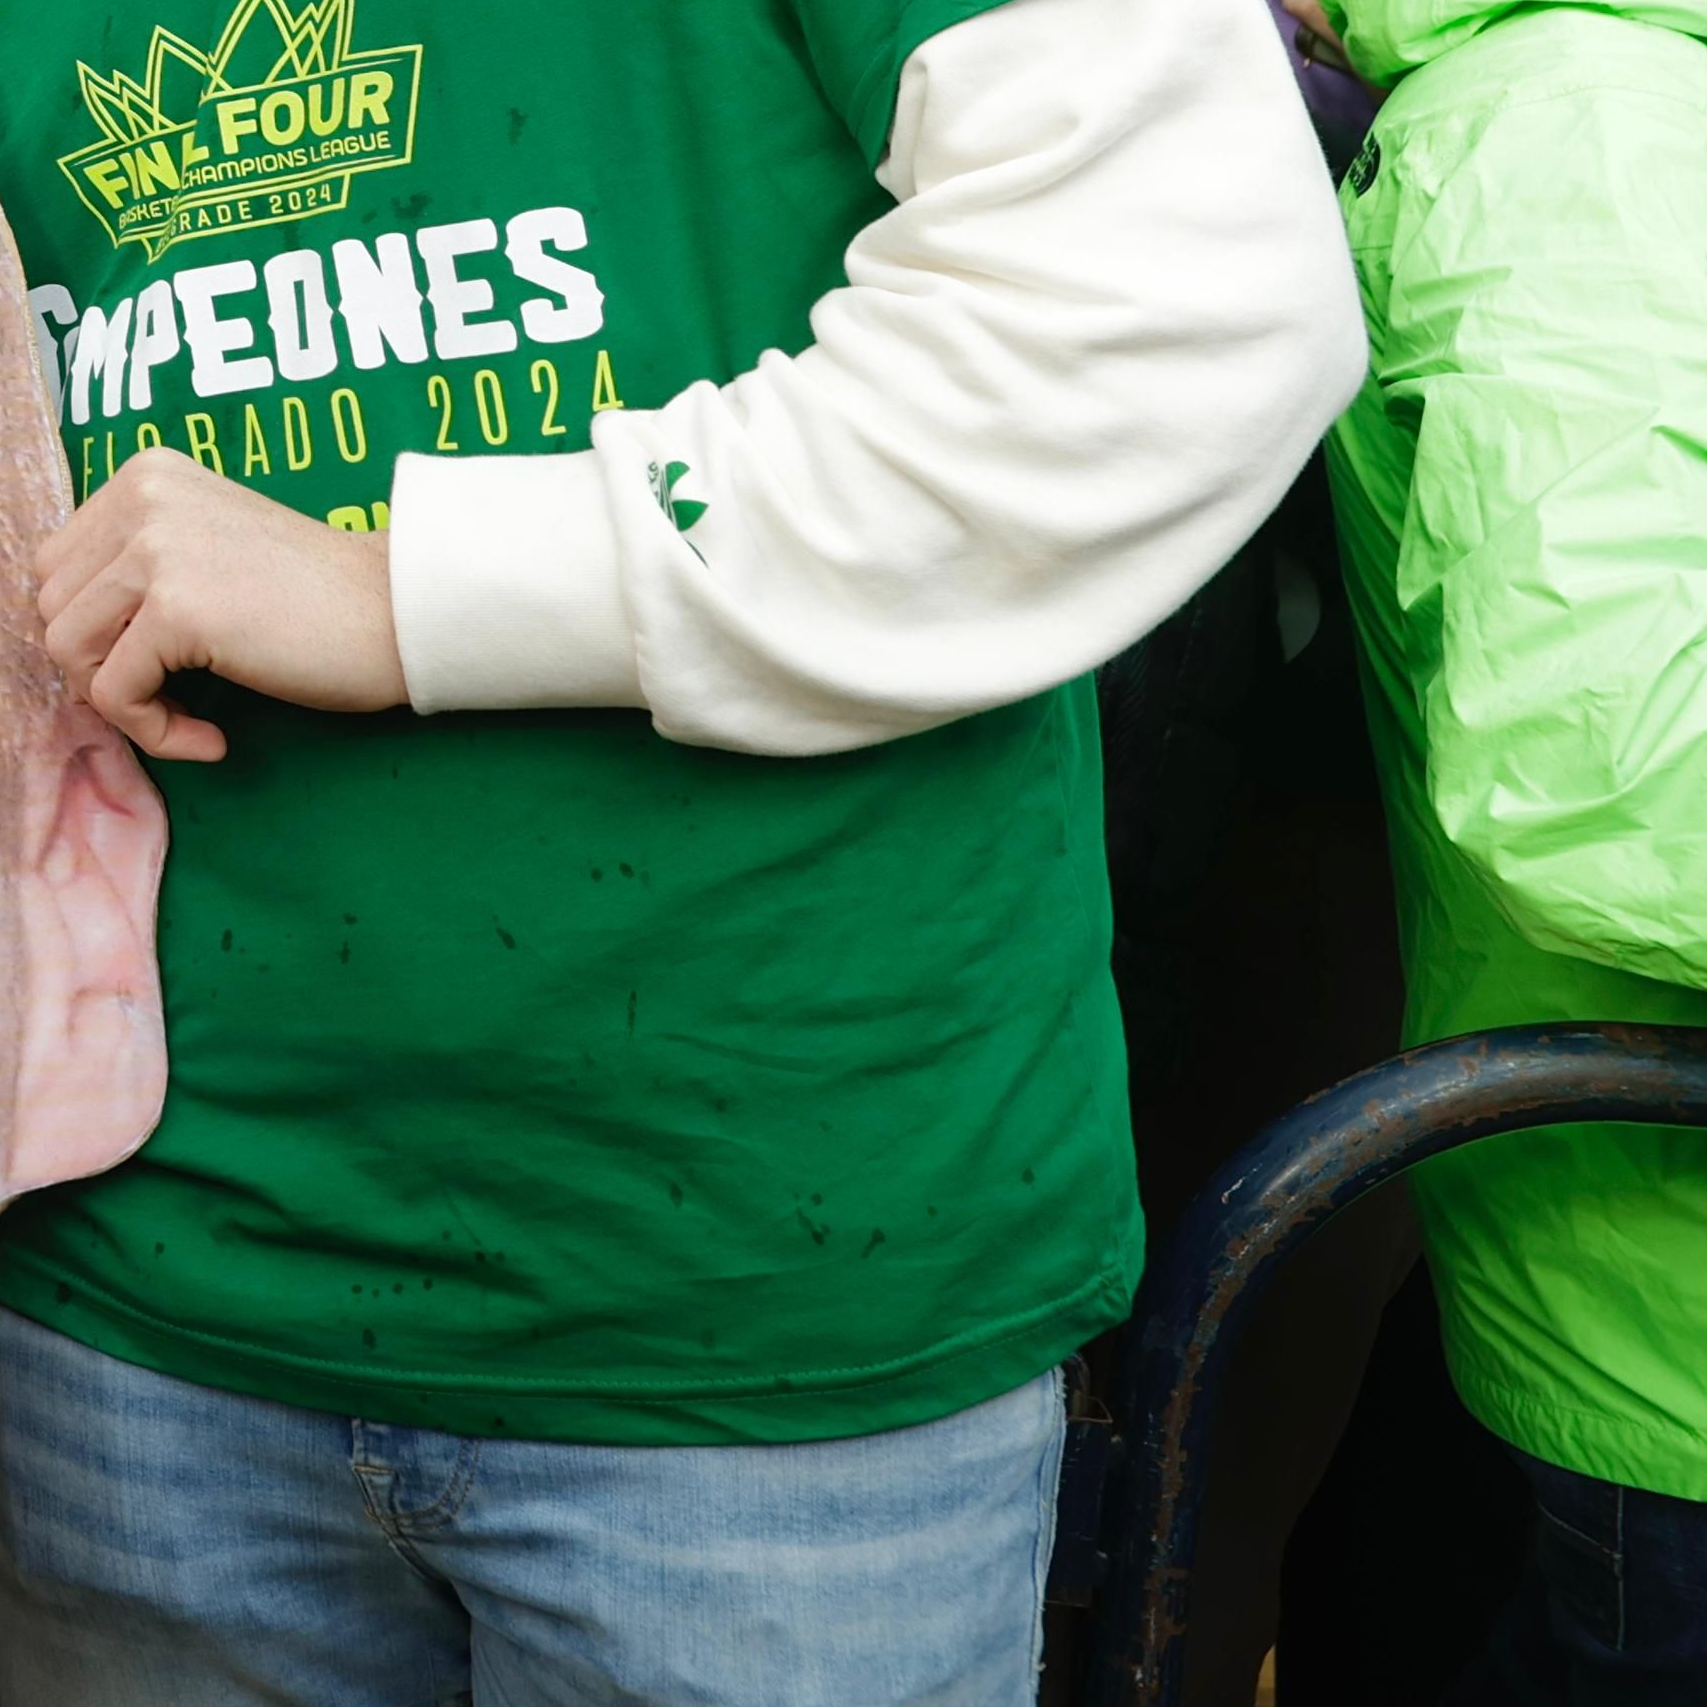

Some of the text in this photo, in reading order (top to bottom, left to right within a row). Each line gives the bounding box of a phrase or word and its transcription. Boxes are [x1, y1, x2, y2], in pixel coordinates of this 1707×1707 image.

[83, 70, 395, 210] FINL FOUR
[310, 130, 392, 164] LEAGUE
[269, 183, 333, 215] 2024
[427, 349, 625, 452] 2024
